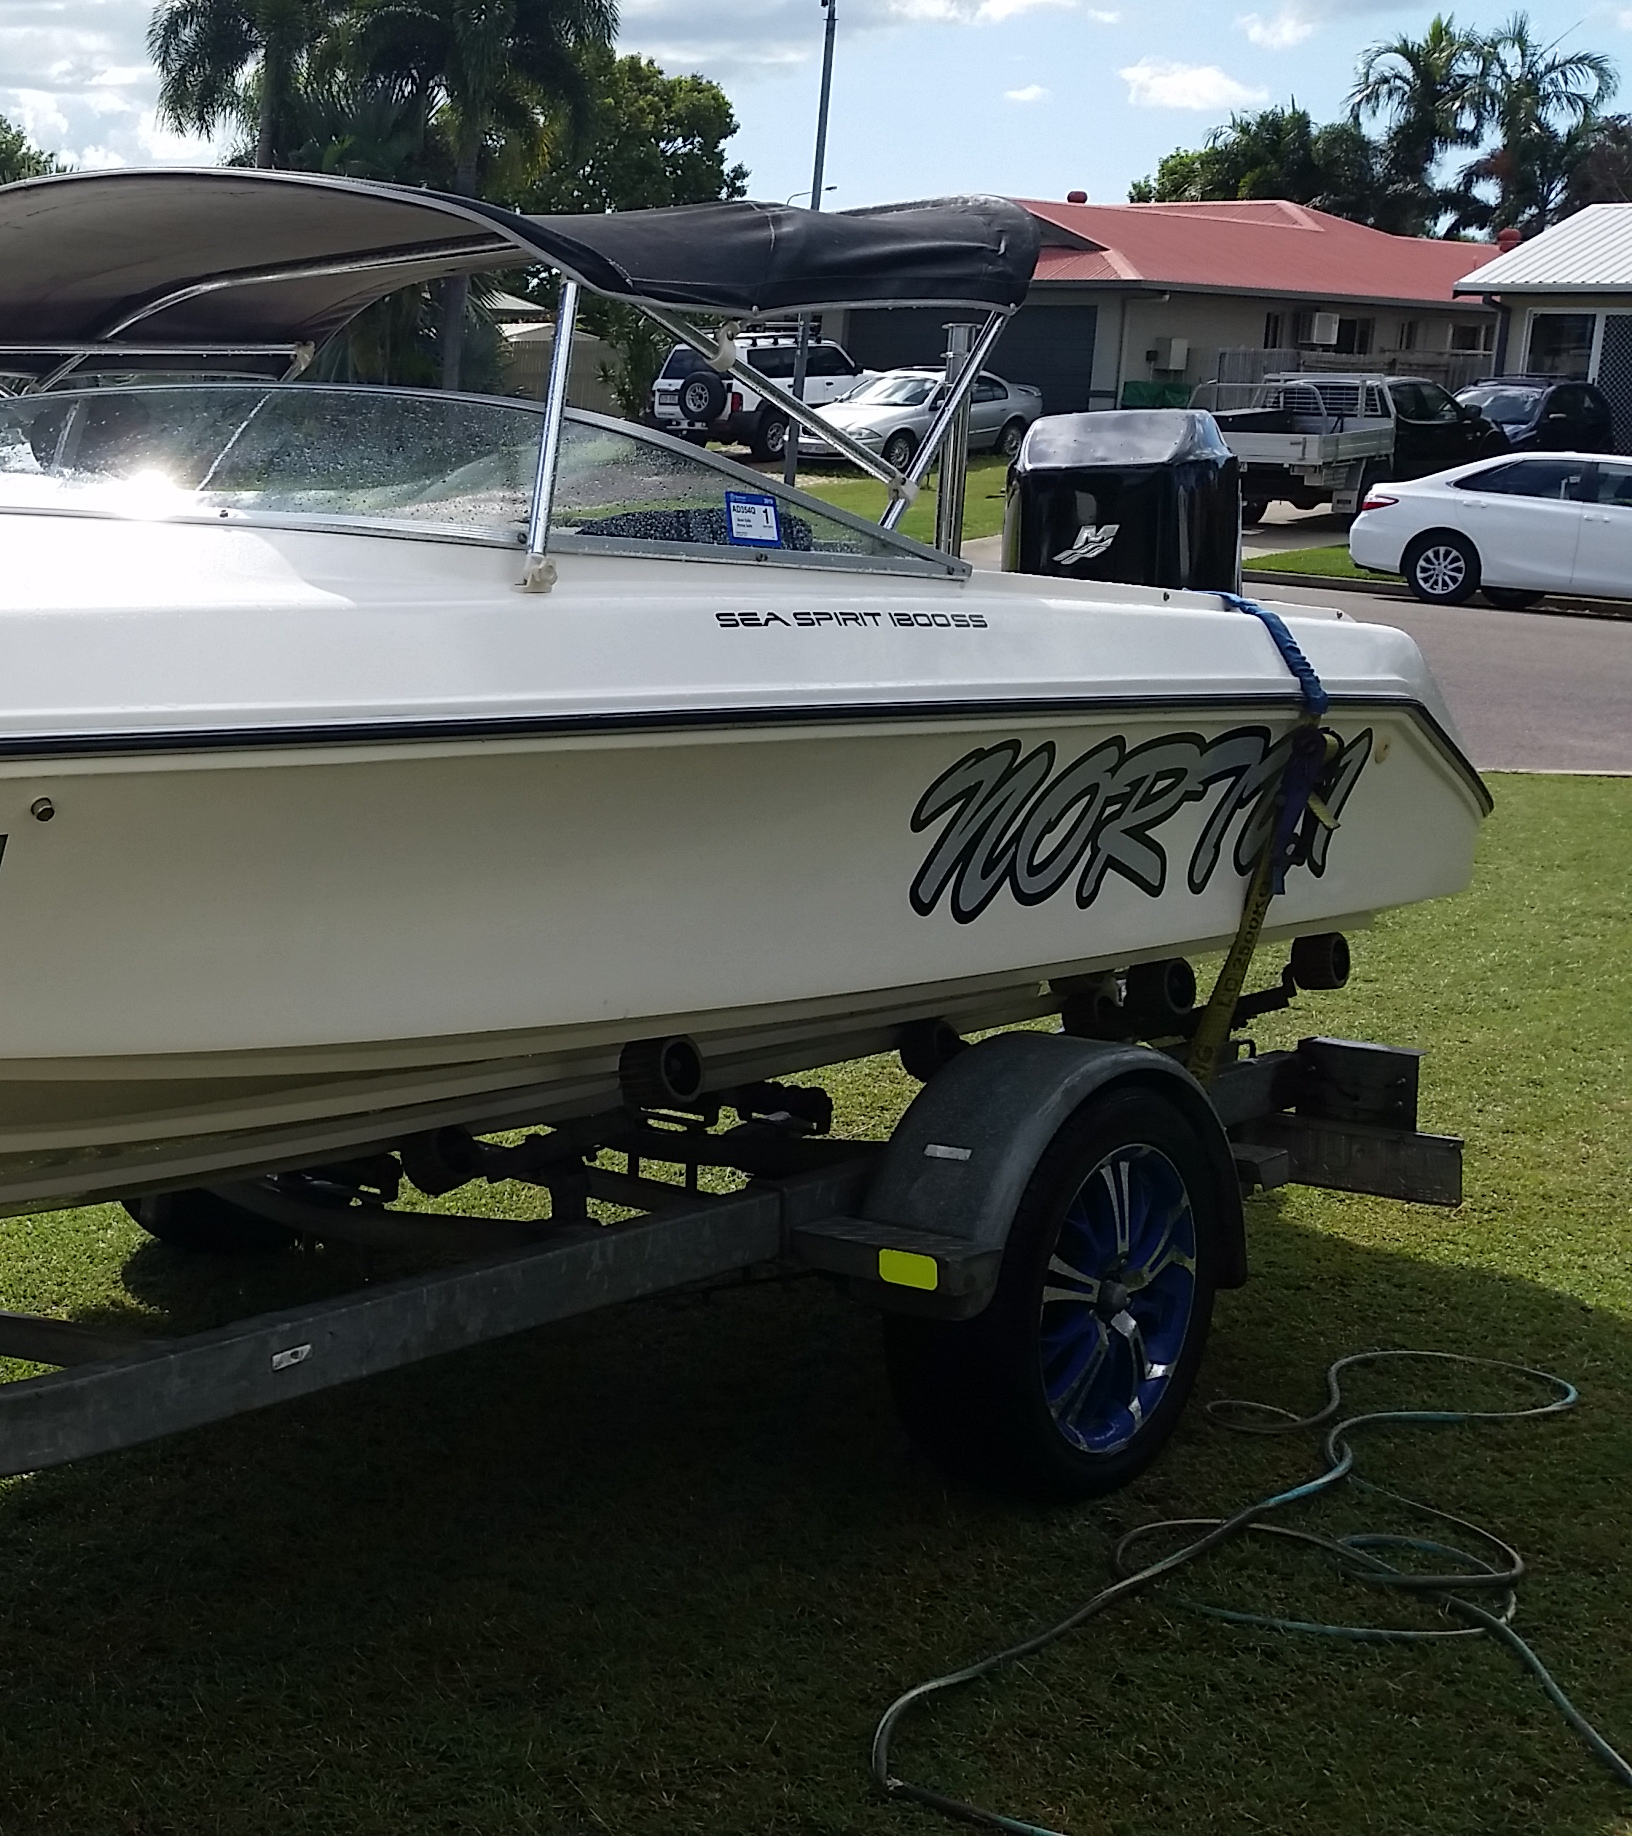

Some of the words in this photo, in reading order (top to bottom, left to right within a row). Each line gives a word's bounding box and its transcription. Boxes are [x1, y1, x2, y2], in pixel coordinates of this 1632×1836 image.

[762, 508, 769, 524] 1
[715, 612, 791, 627] SEA
[792, 612, 881, 627] SPIRIT
